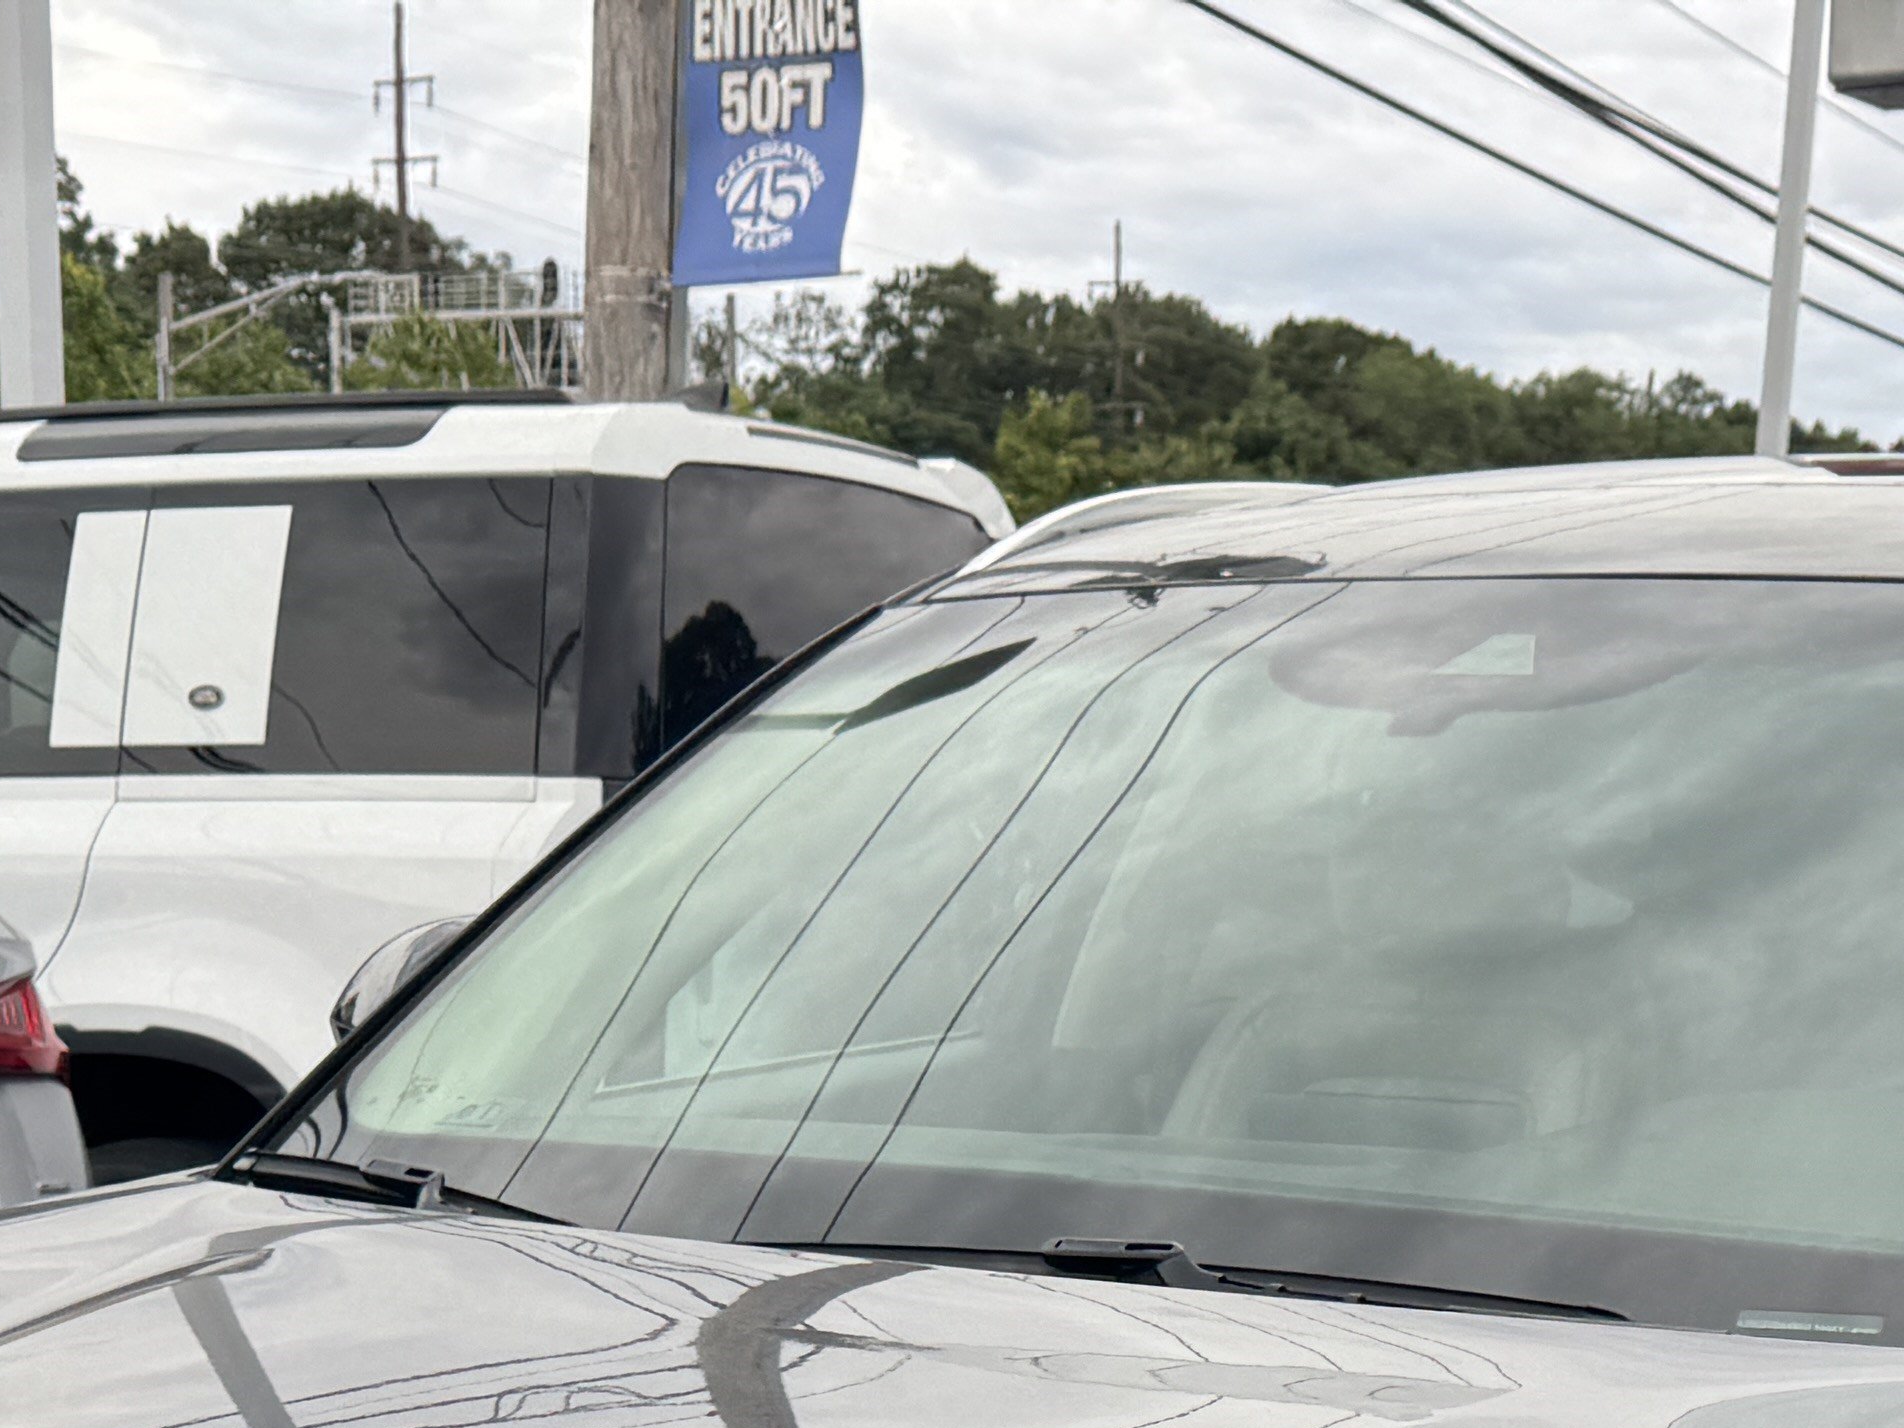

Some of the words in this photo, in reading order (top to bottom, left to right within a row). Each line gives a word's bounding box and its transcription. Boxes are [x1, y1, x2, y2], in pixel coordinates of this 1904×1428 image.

[693, 0, 857, 62] ENTRANCE
[720, 61, 834, 136] 50FT
[726, 160, 811, 230] 45
